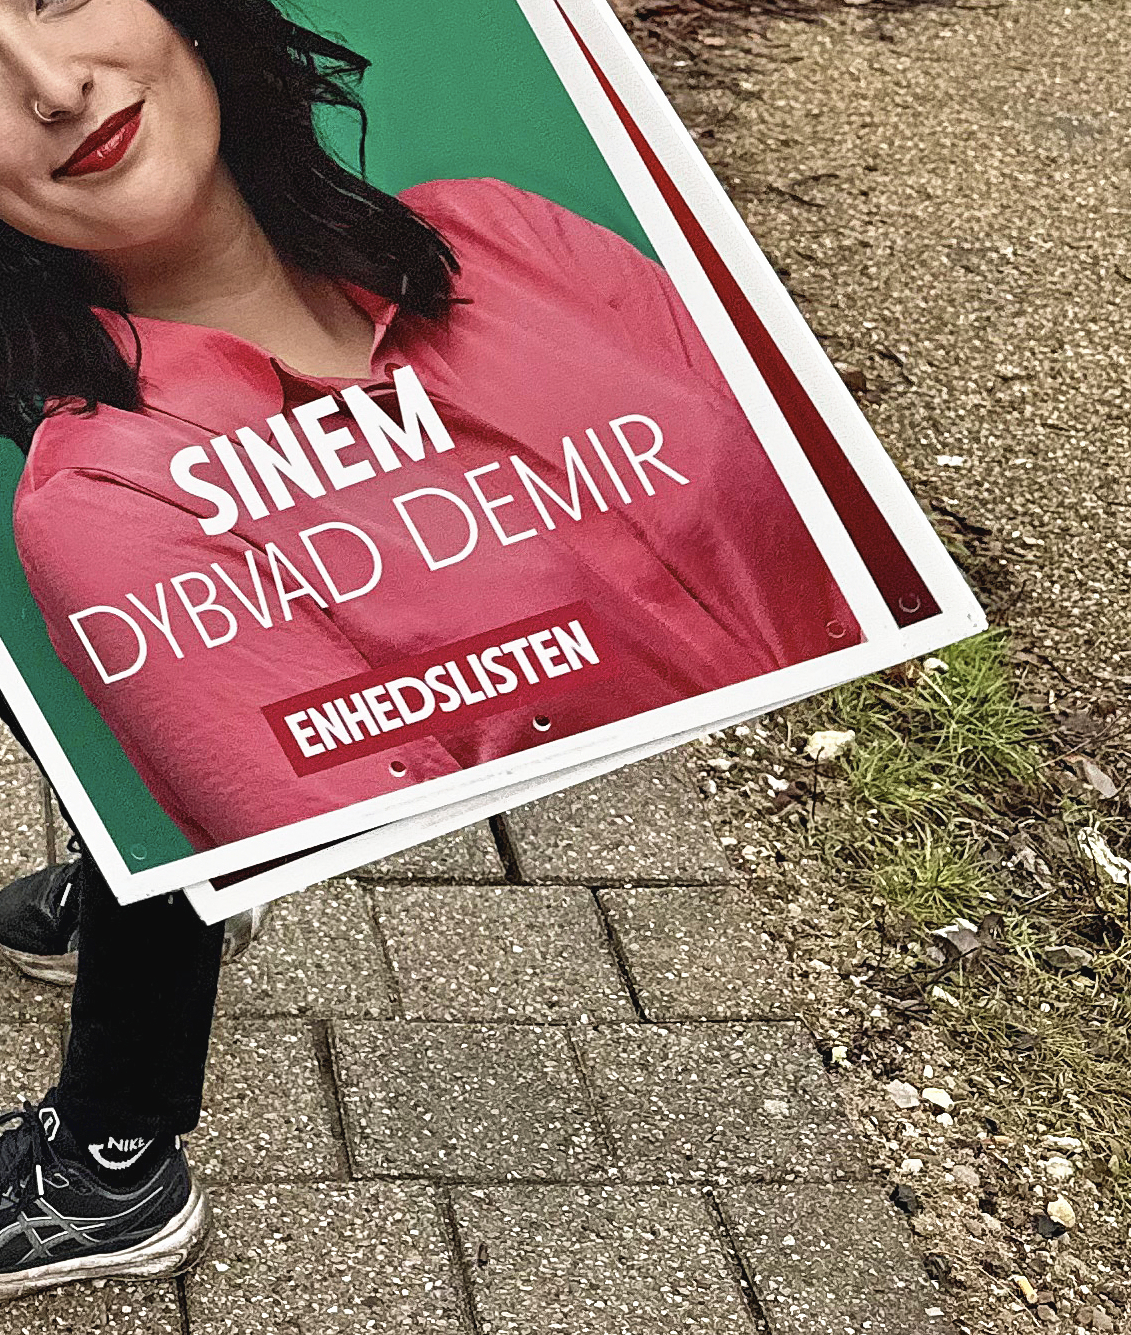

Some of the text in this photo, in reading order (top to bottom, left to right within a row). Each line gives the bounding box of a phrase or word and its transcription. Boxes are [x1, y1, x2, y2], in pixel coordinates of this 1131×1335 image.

[169, 364, 456, 537] SINEM
[68, 413, 691, 685] DYBVAD DEMIR
[286, 619, 600, 757] ENHEDSLISTEN
[107, 1136, 145, 1152] NIKE
